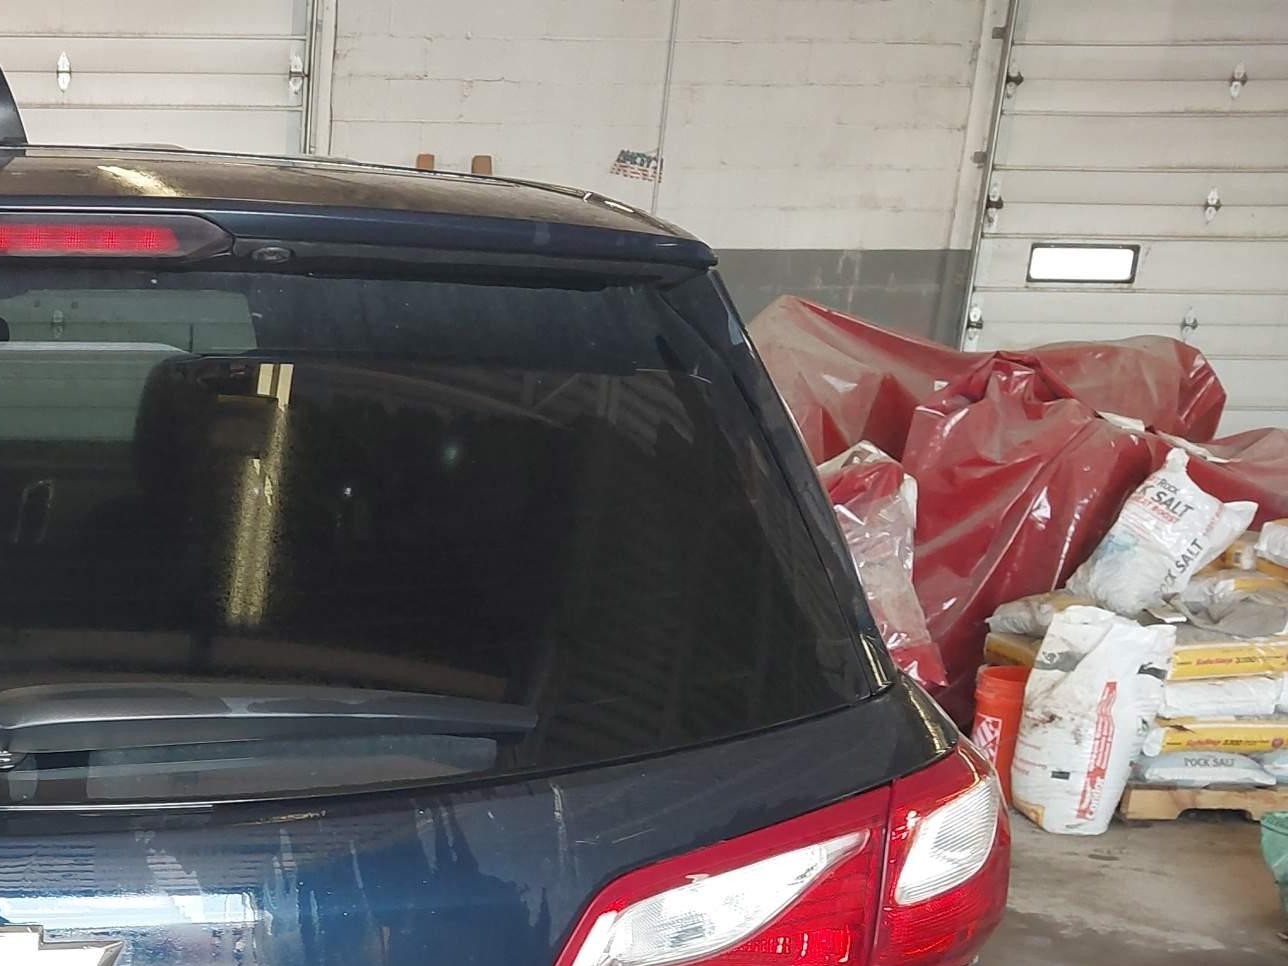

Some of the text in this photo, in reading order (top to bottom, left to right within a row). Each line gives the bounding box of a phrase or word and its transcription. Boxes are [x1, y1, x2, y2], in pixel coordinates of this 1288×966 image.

[1150, 490, 1195, 517] SALT
[1175, 538, 1204, 574] SALT
[1212, 757, 1236, 768] SALT
